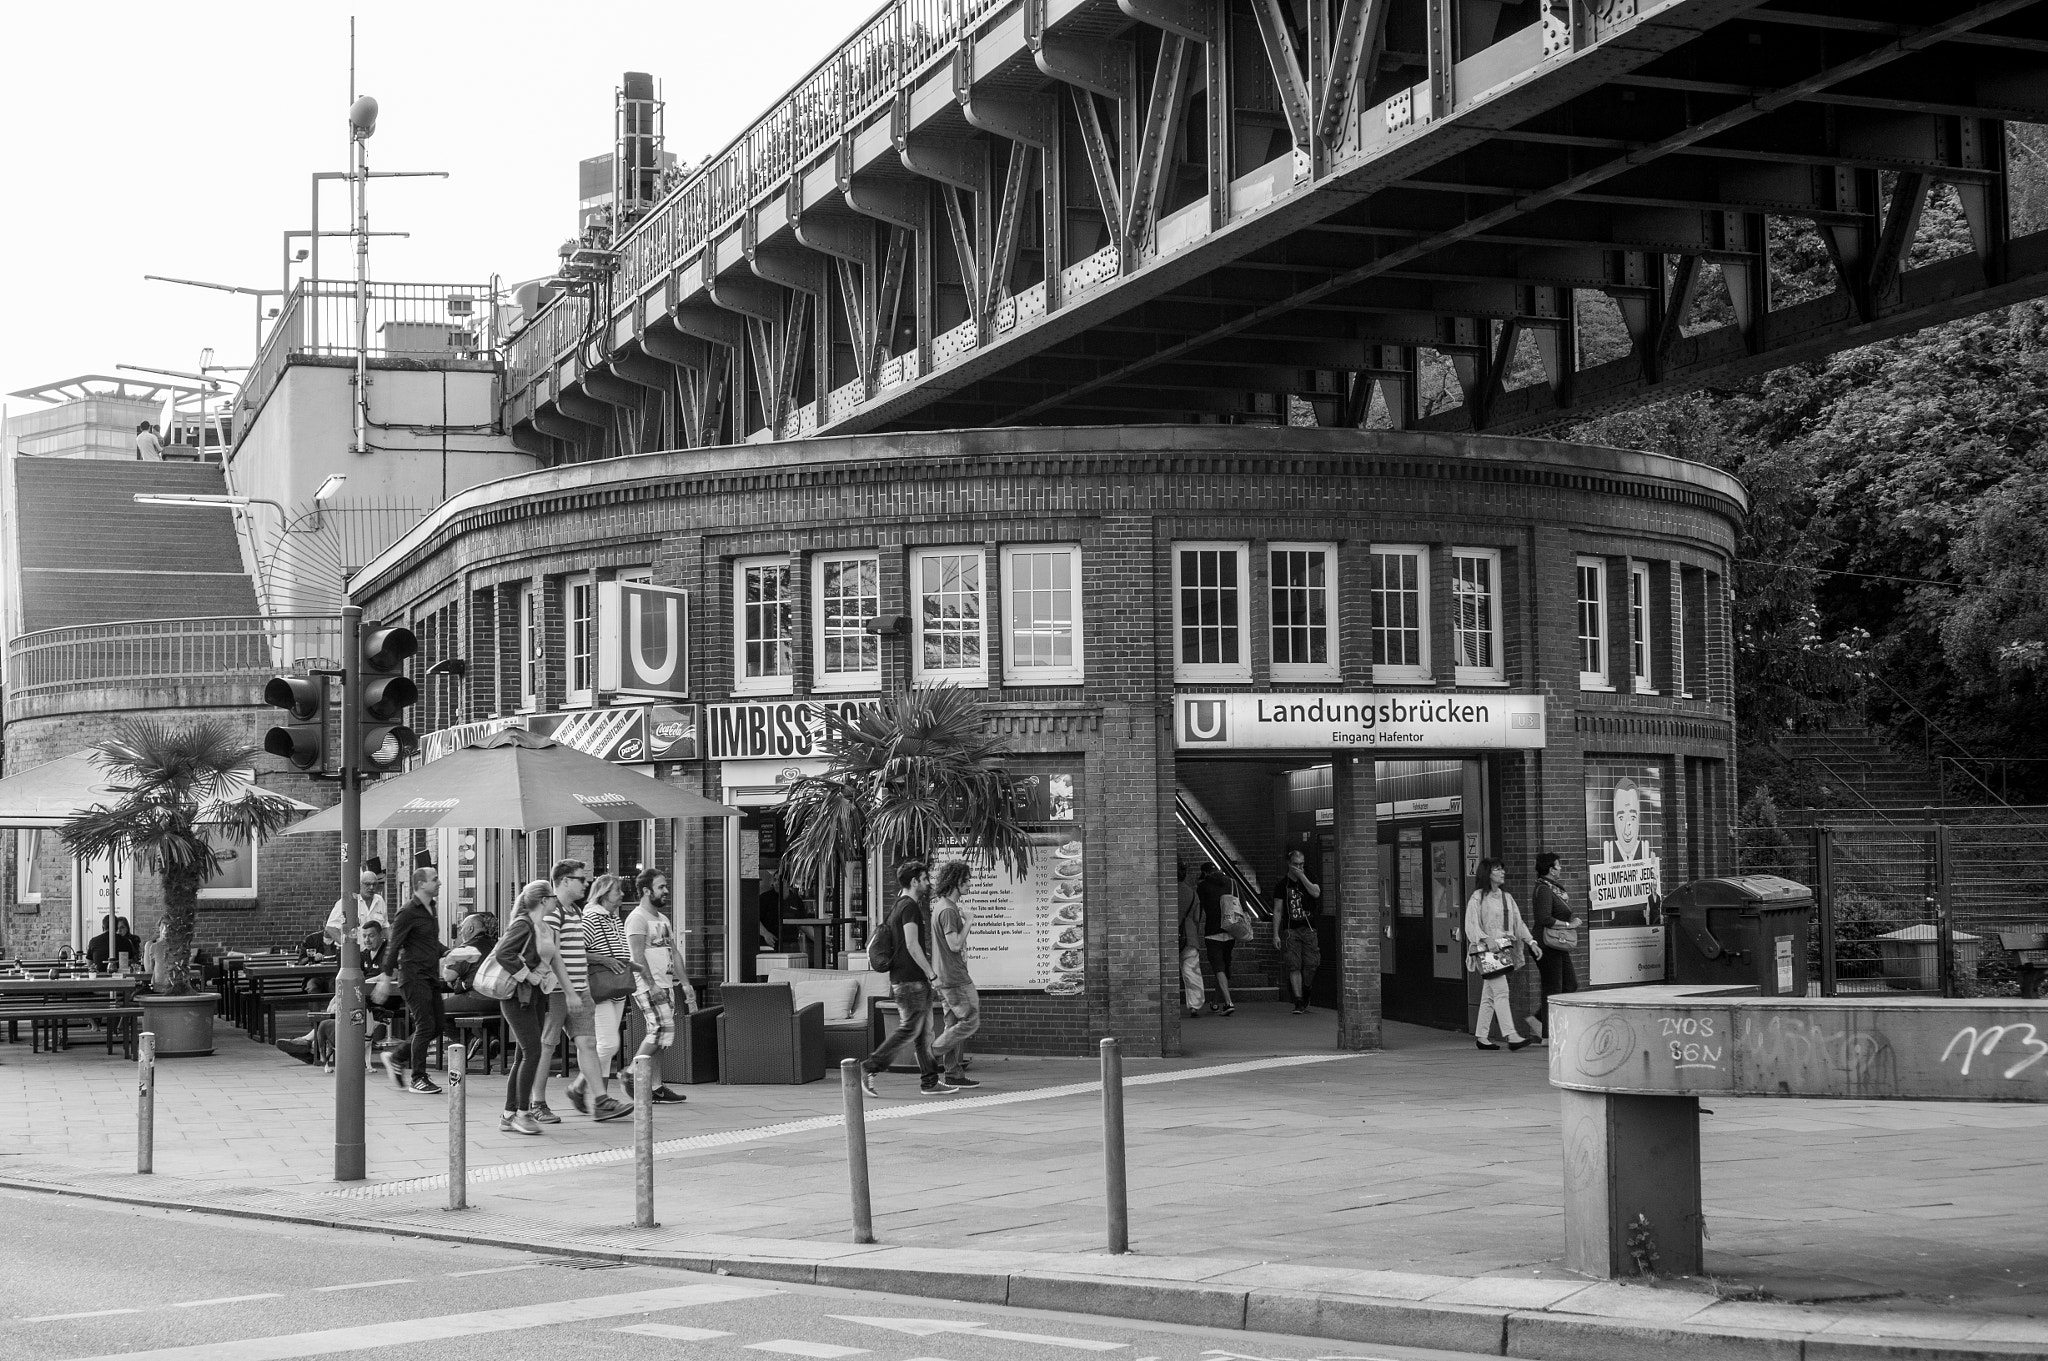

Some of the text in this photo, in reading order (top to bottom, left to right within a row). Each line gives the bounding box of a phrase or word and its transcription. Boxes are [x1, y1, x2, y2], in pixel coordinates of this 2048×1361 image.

[629, 592, 678, 686] U
[710, 702, 882, 756] IMBISS-E
[1190, 701, 1221, 739] U
[1257, 697, 1489, 729] Landungsbrücken
[1332, 731, 1424, 745] Eingang Hafentor
[1593, 873, 1606, 887] ICH
[1598, 887, 1617, 901] STAU
[1618, 884, 1632, 899] VON
